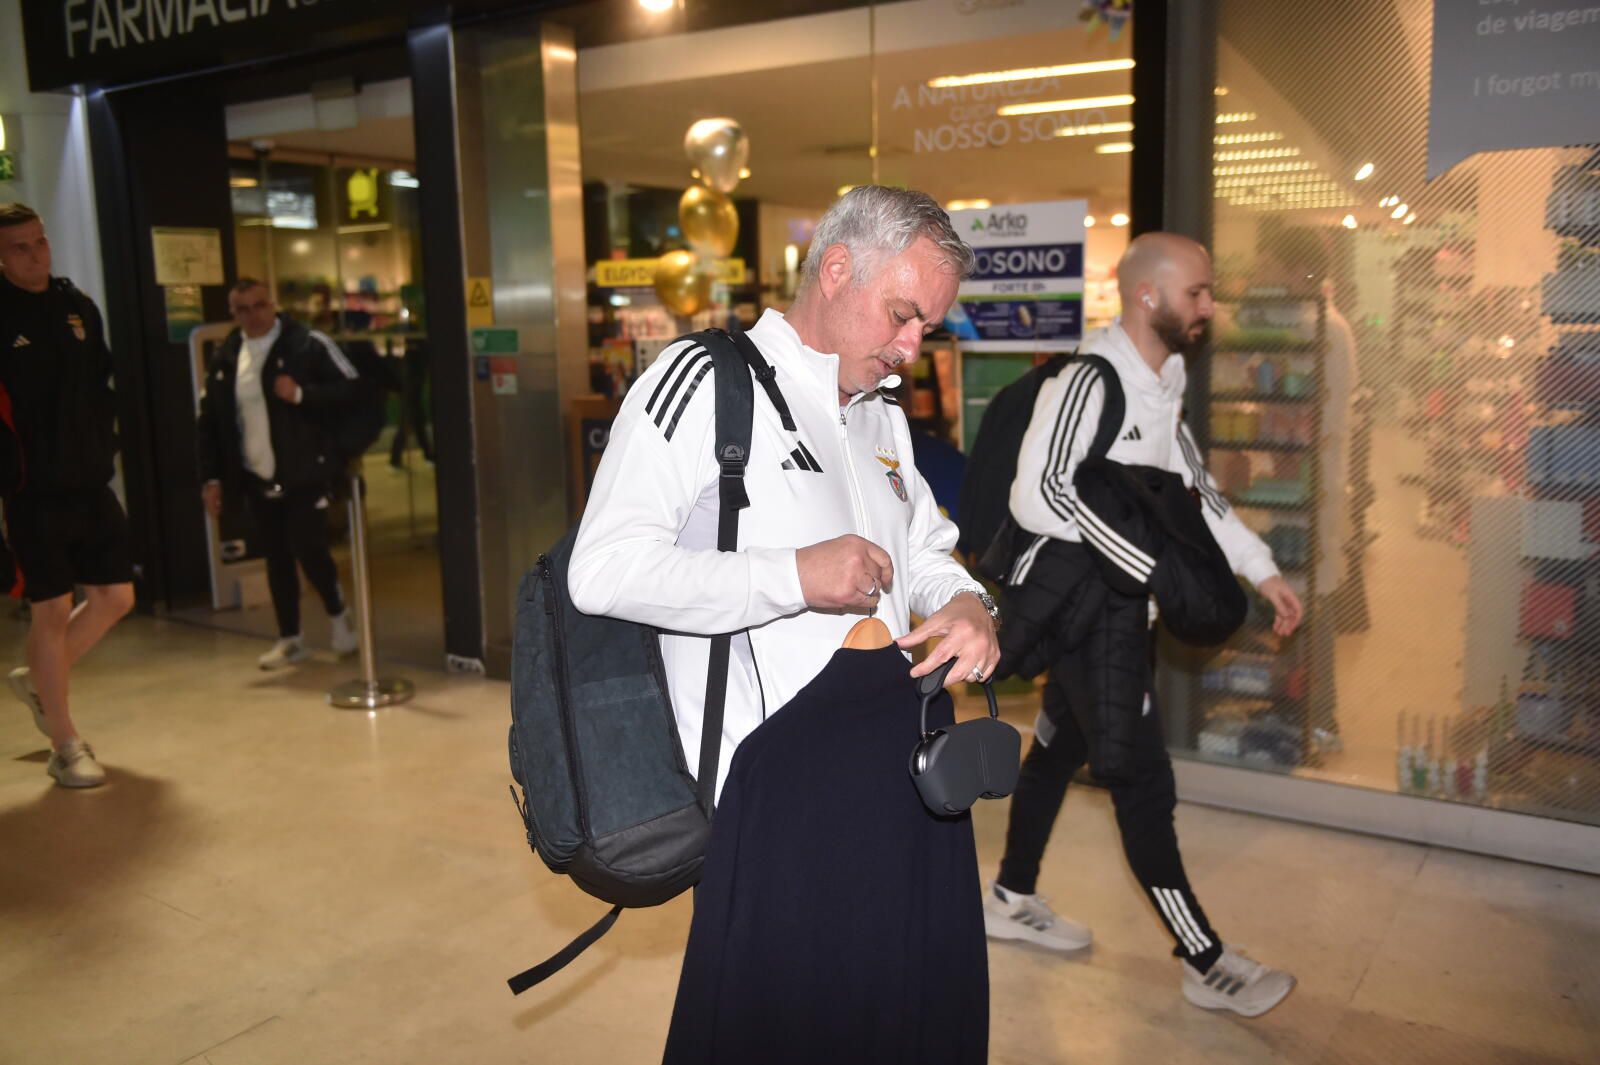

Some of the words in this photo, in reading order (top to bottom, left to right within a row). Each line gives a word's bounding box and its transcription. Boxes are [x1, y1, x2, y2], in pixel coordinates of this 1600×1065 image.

[64, 0, 299, 58] FARMA
[1475, 13, 1508, 36] de
[1487, 70, 1562, 97] forgot
[892, 84, 913, 111] A
[913, 119, 1012, 154] NOSSO
[987, 212, 1028, 232] Arko
[974, 248, 1067, 276] OSONO
